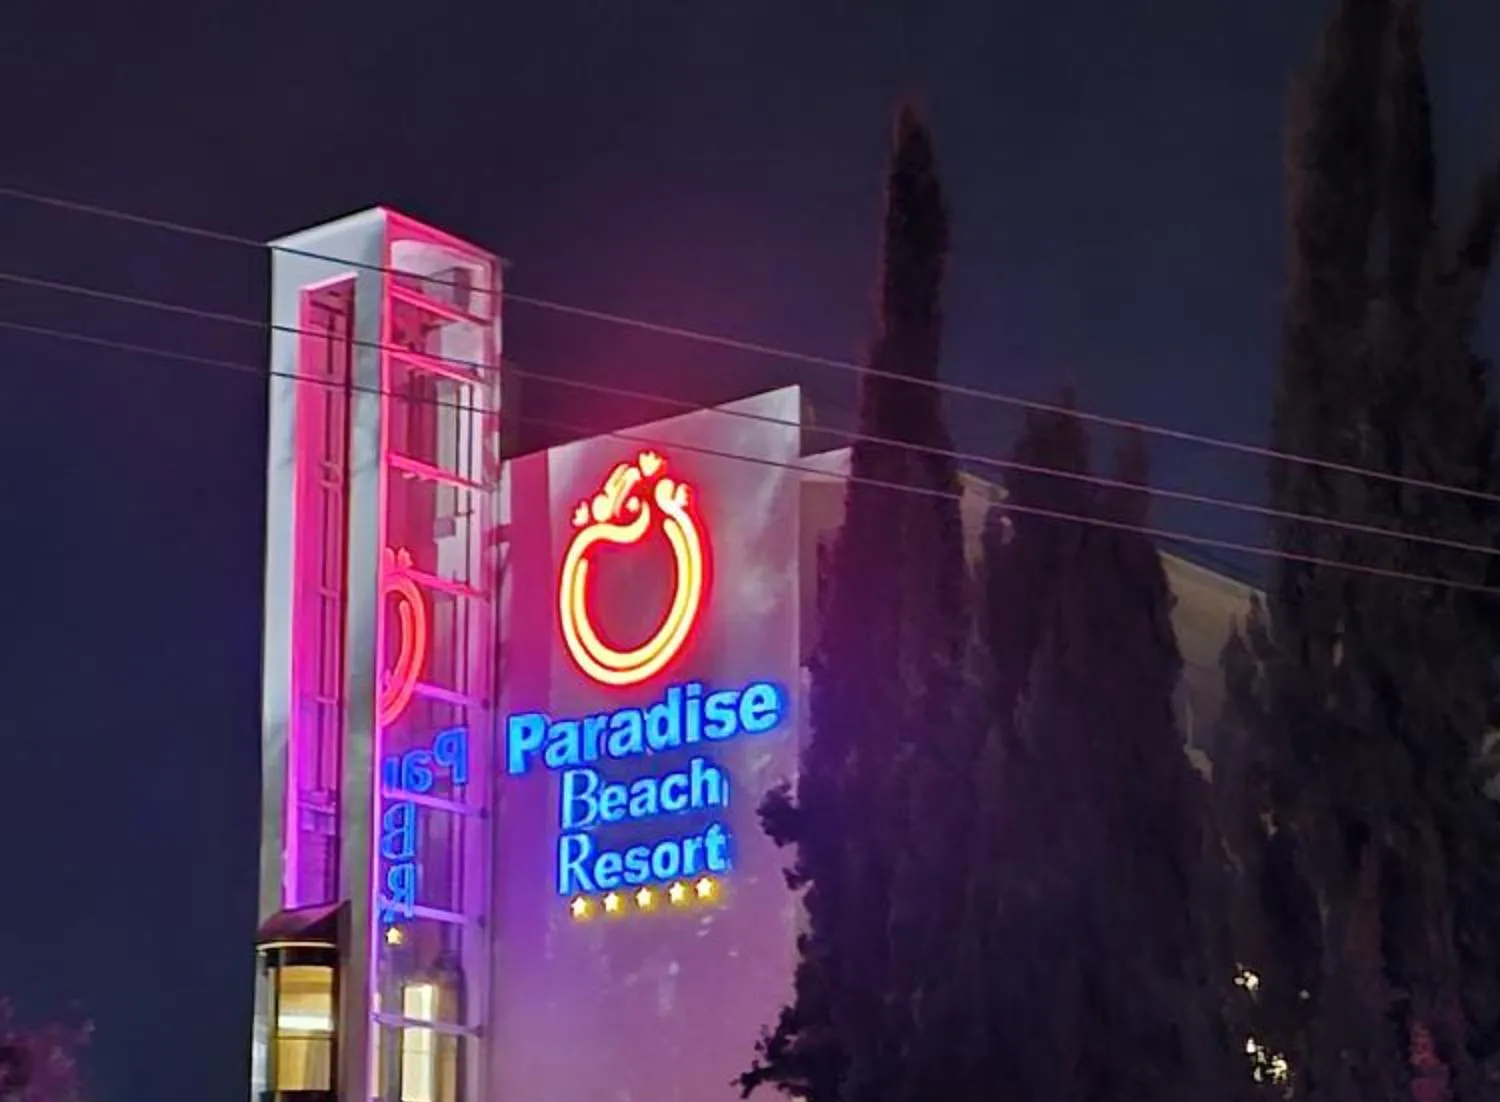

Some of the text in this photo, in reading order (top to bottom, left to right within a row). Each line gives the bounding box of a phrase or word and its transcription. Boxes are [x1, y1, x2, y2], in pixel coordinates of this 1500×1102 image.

[505, 681, 783, 775] Paradise
[559, 756, 728, 831] Beach
[557, 823, 728, 895] Resort
